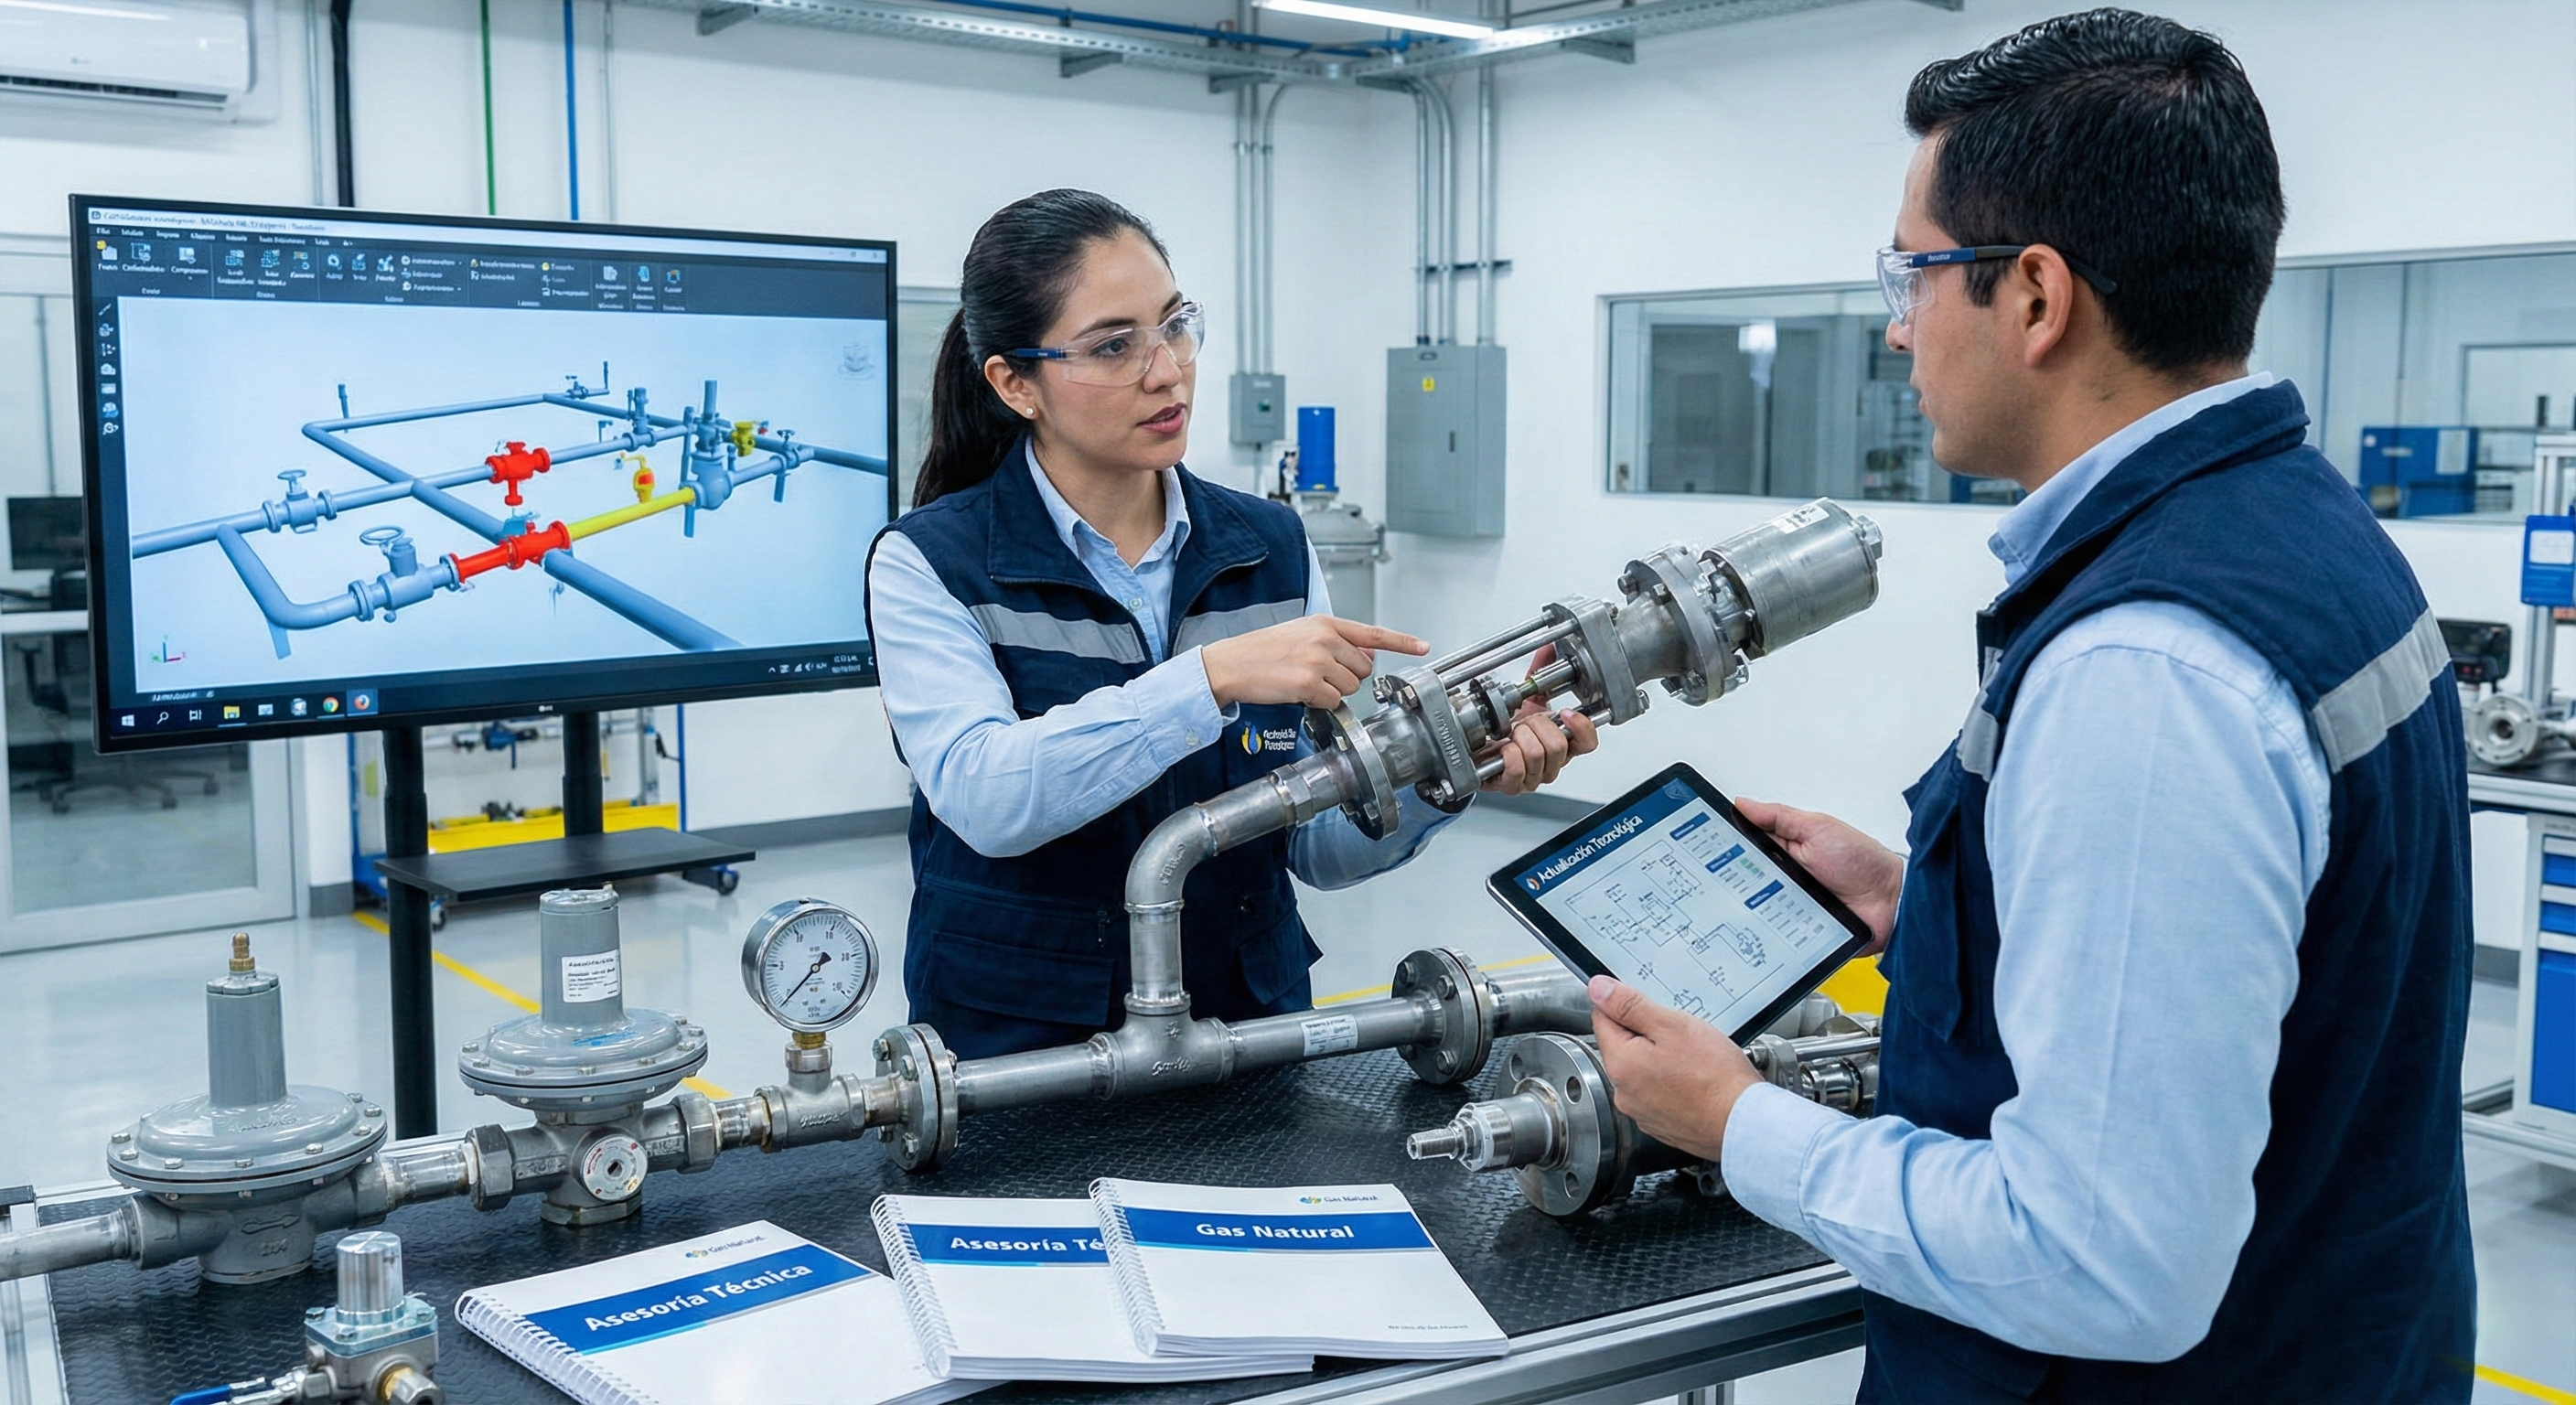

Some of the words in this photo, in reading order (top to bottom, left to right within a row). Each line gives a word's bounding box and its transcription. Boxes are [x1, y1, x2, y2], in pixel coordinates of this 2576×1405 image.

[1196, 1223, 1246, 1237] Gas
[1252, 1225, 1355, 1239] Natural
[950, 1237, 1068, 1251] Asesoría
[584, 1294, 709, 1332] Asesoría
[703, 1264, 813, 1299] Técnica
